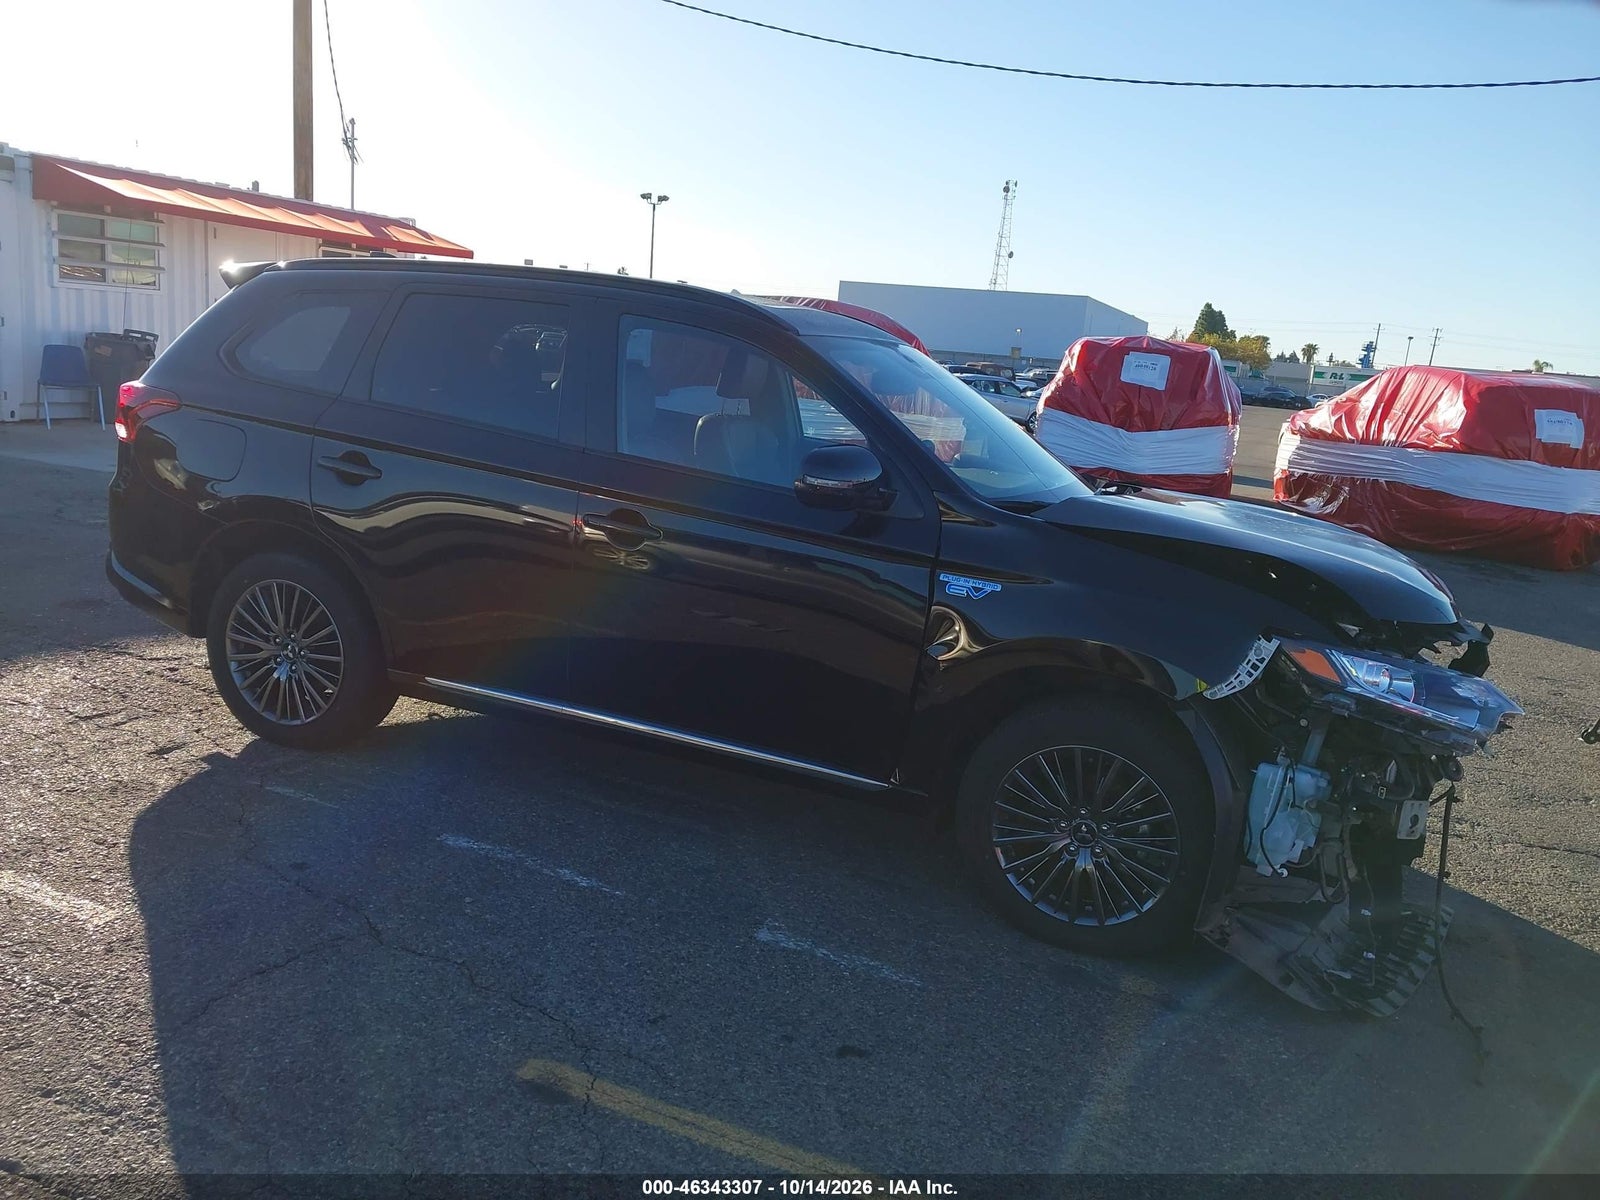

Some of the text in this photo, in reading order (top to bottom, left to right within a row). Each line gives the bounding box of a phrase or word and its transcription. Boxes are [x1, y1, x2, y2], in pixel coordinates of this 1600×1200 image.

[942, 574, 1000, 590] PLUG-IN HYBRID
[945, 583, 992, 600] EV
